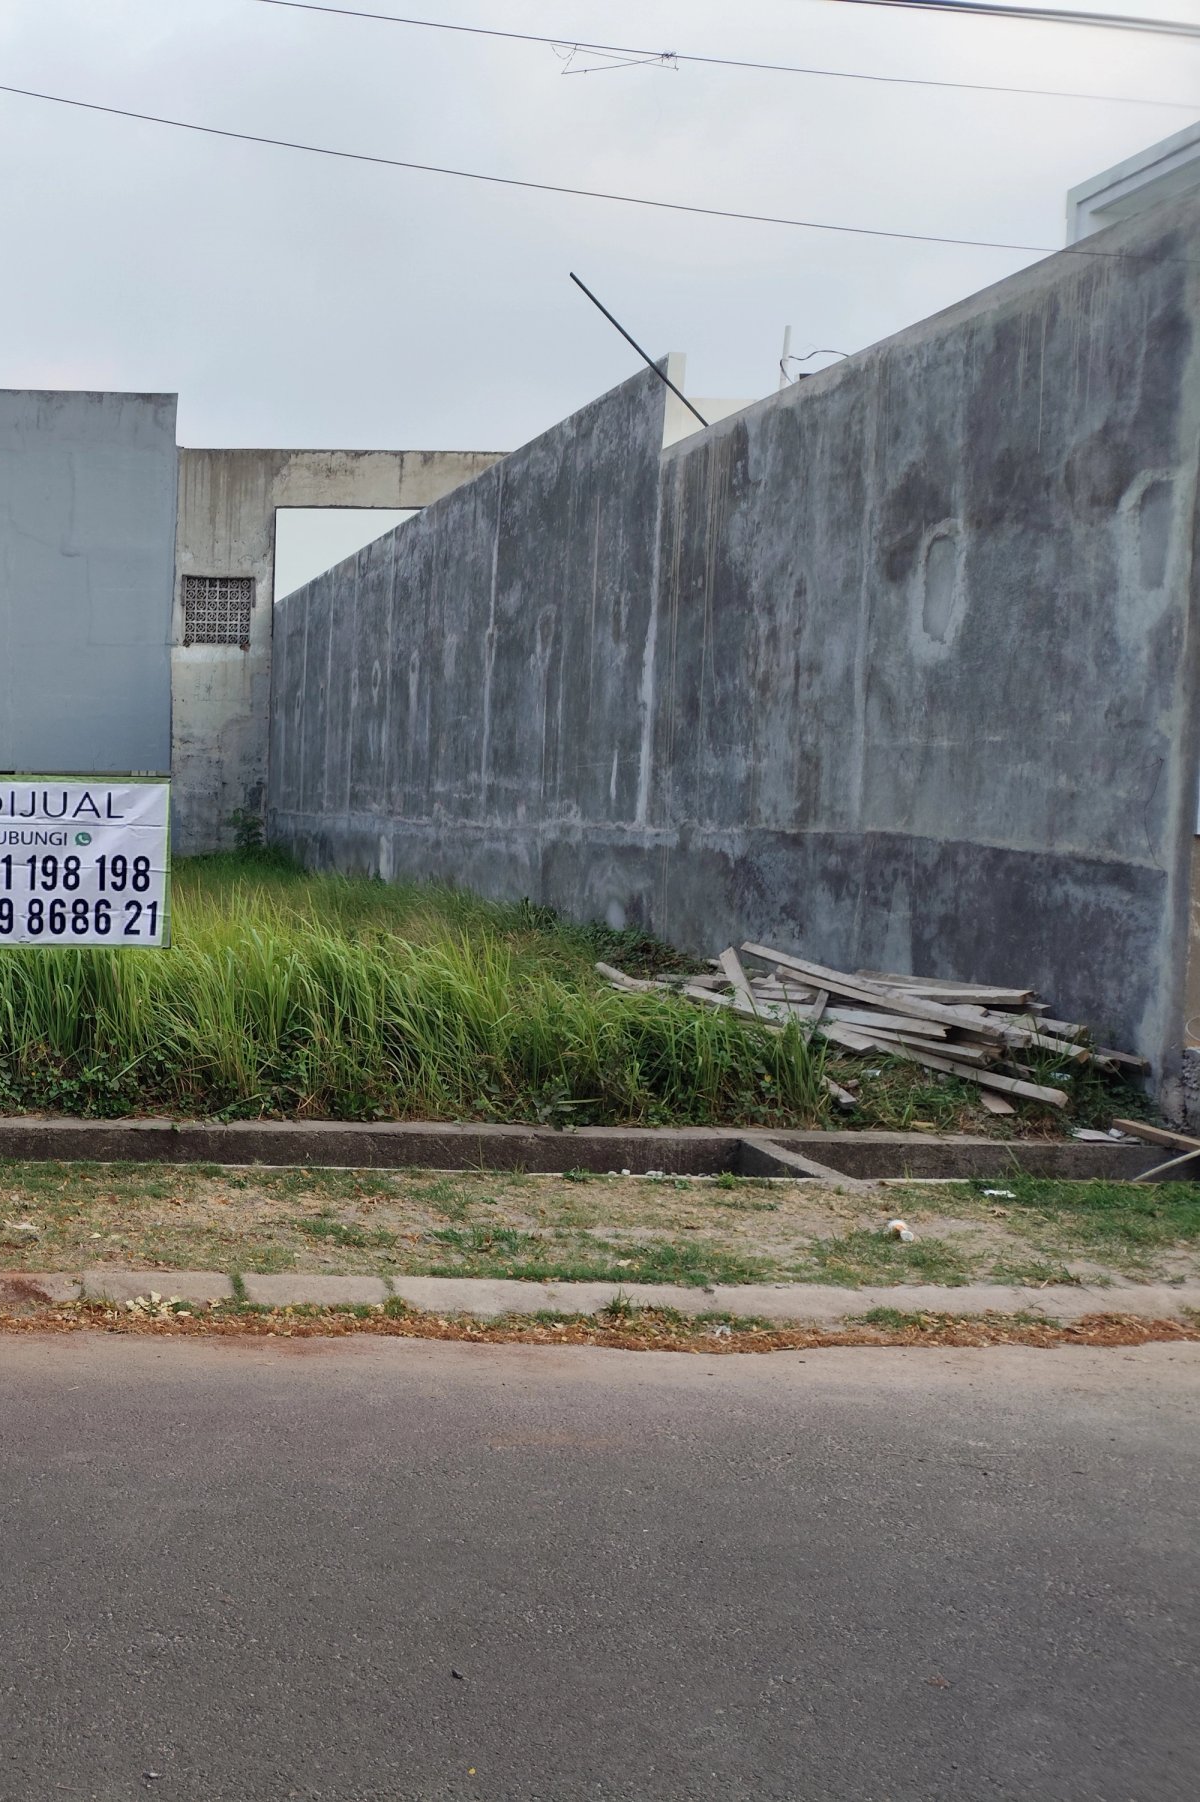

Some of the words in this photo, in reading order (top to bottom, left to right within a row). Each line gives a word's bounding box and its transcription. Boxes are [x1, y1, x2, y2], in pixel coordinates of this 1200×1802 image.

[26, 854, 81, 891] 198
[95, 854, 151, 892] 198
[27, 898, 112, 936] 8686
[123, 900, 158, 937] 21
